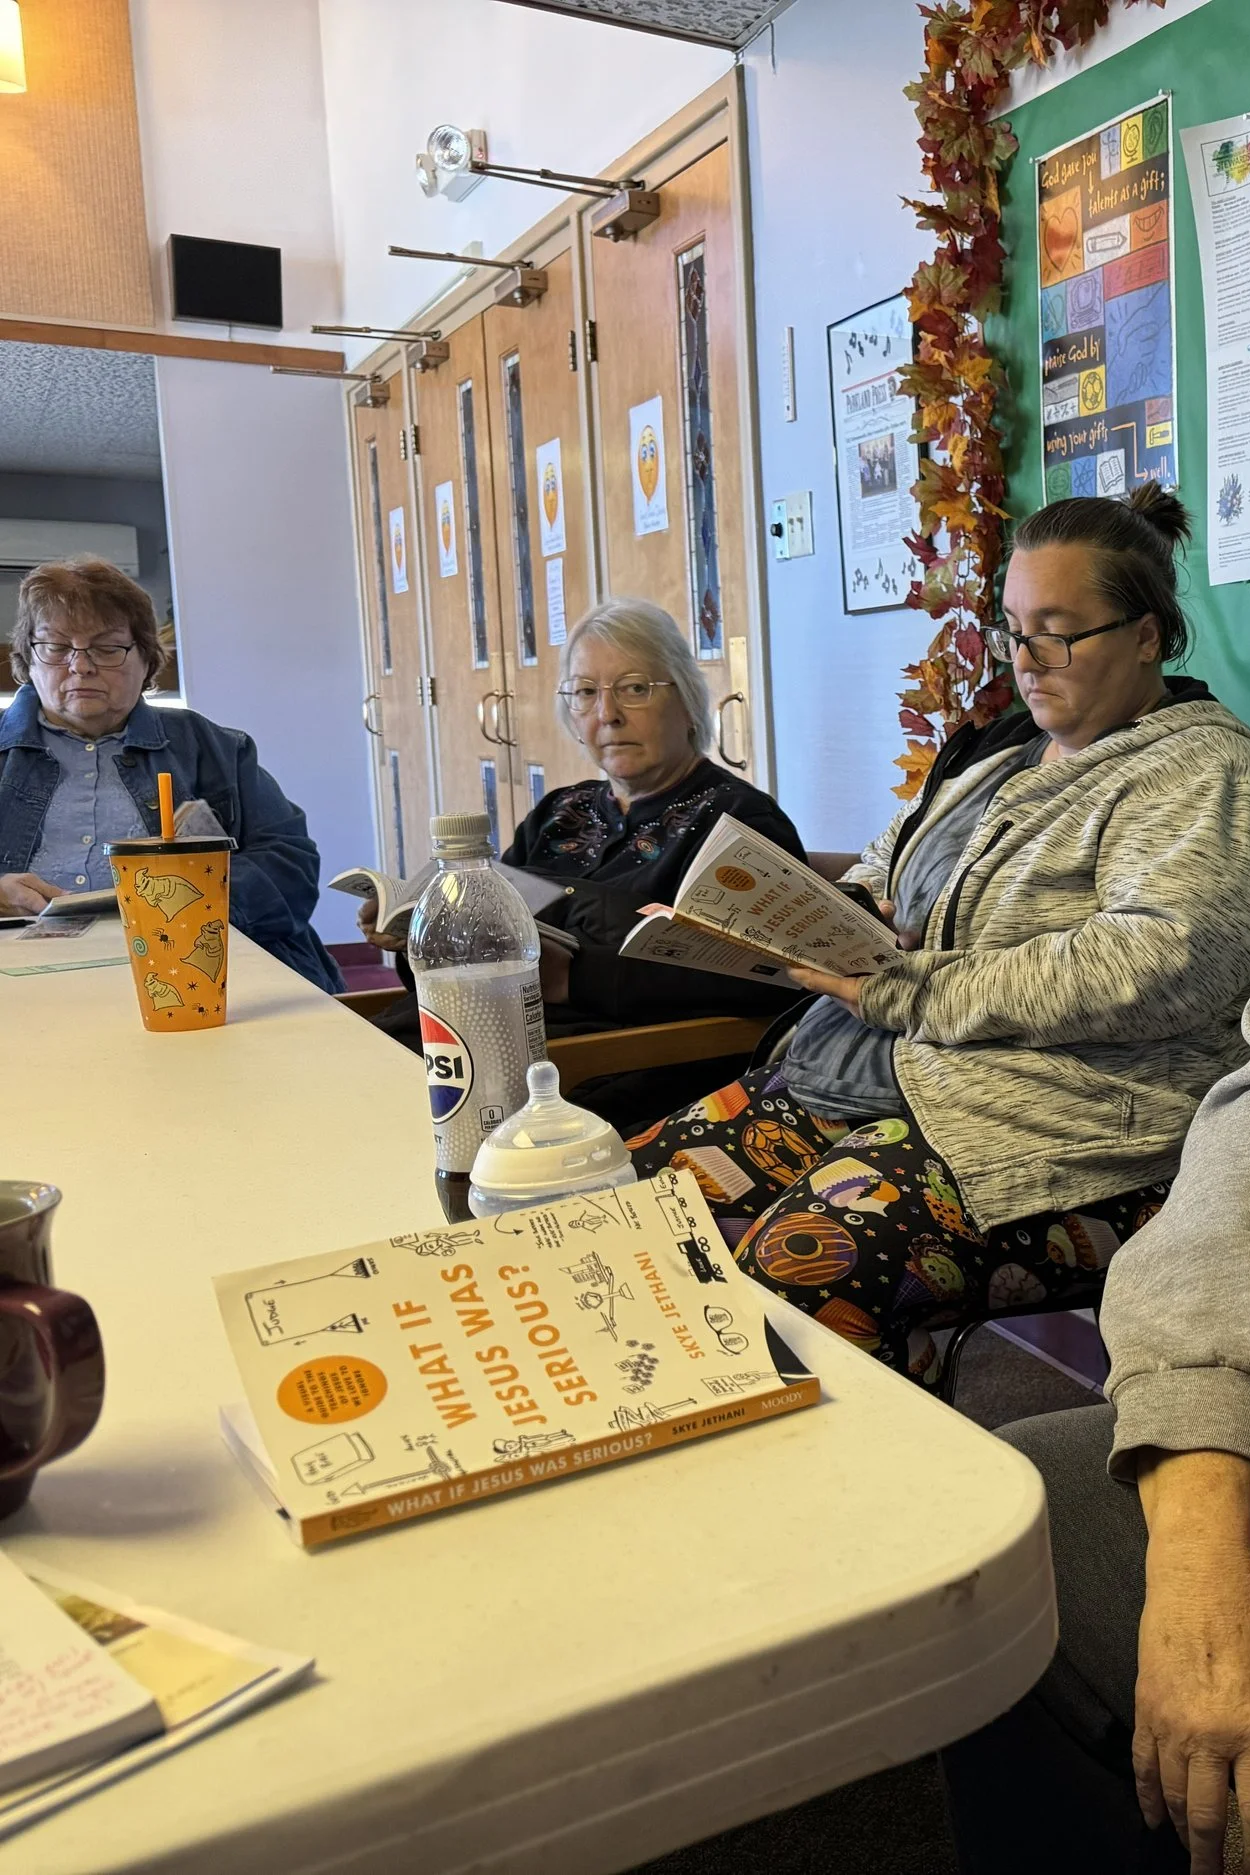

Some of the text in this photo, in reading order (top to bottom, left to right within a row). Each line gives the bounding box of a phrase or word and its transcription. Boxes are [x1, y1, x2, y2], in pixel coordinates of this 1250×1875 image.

[1042, 152, 1097, 189] God gave you
[1088, 170, 1164, 219] talents as a gift;
[1044, 334, 1100, 376] praise God by
[1046, 419, 1108, 456] using your gifts
[1150, 455, 1171, 479] well.
[747, 881, 792, 917] WHAT IF
[764, 890, 817, 933] JESUS WAS
[785, 905, 833, 939] SERIOUS?
[489, 1109, 494, 1119] 0
[264, 1298, 283, 1338] JUDGE
[633, 1251, 706, 1359] SKYE JETHANI
[441, 1263, 548, 1426] JESUS WAS
[498, 1265, 598, 1406] SERIOUS?
[392, 1299, 478, 1429] WHAT IF
[671, 1406, 746, 1436] SKYE JETHANI
[761, 1391, 806, 1411] MOODY
[387, 1431, 655, 1518] WHAT IF JESUS WAS SERIOUS?
